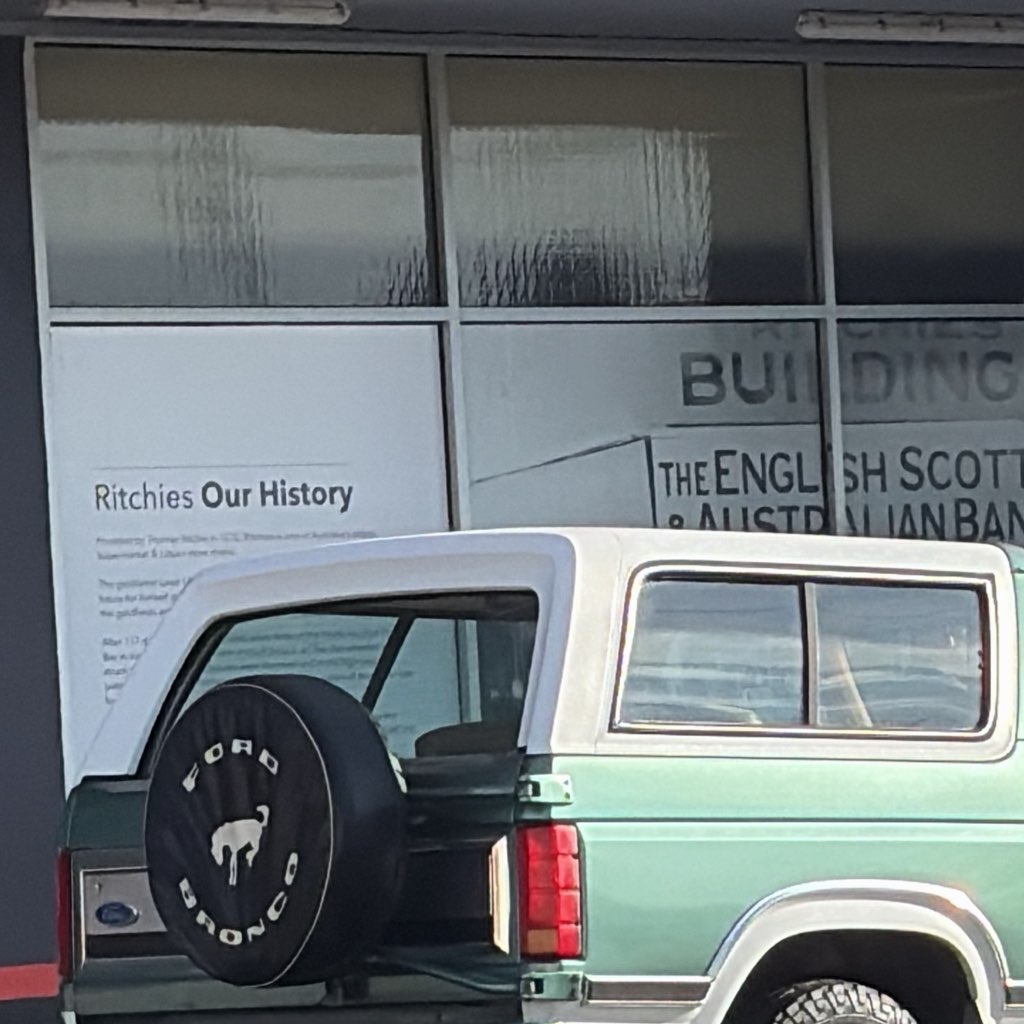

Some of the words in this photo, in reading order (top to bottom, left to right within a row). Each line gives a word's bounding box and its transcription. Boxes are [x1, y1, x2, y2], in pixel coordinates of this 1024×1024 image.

[95, 482, 194, 512] Ritchies
[201, 480, 252, 508] Our
[259, 480, 354, 513] History
[659, 461, 710, 497] THE
[714, 449, 887, 495] ENGLSH
[699, 502, 946, 540] AUSTRLIAN
[182, 738, 279, 792] FORD
[178, 851, 299, 946] BRONCO
